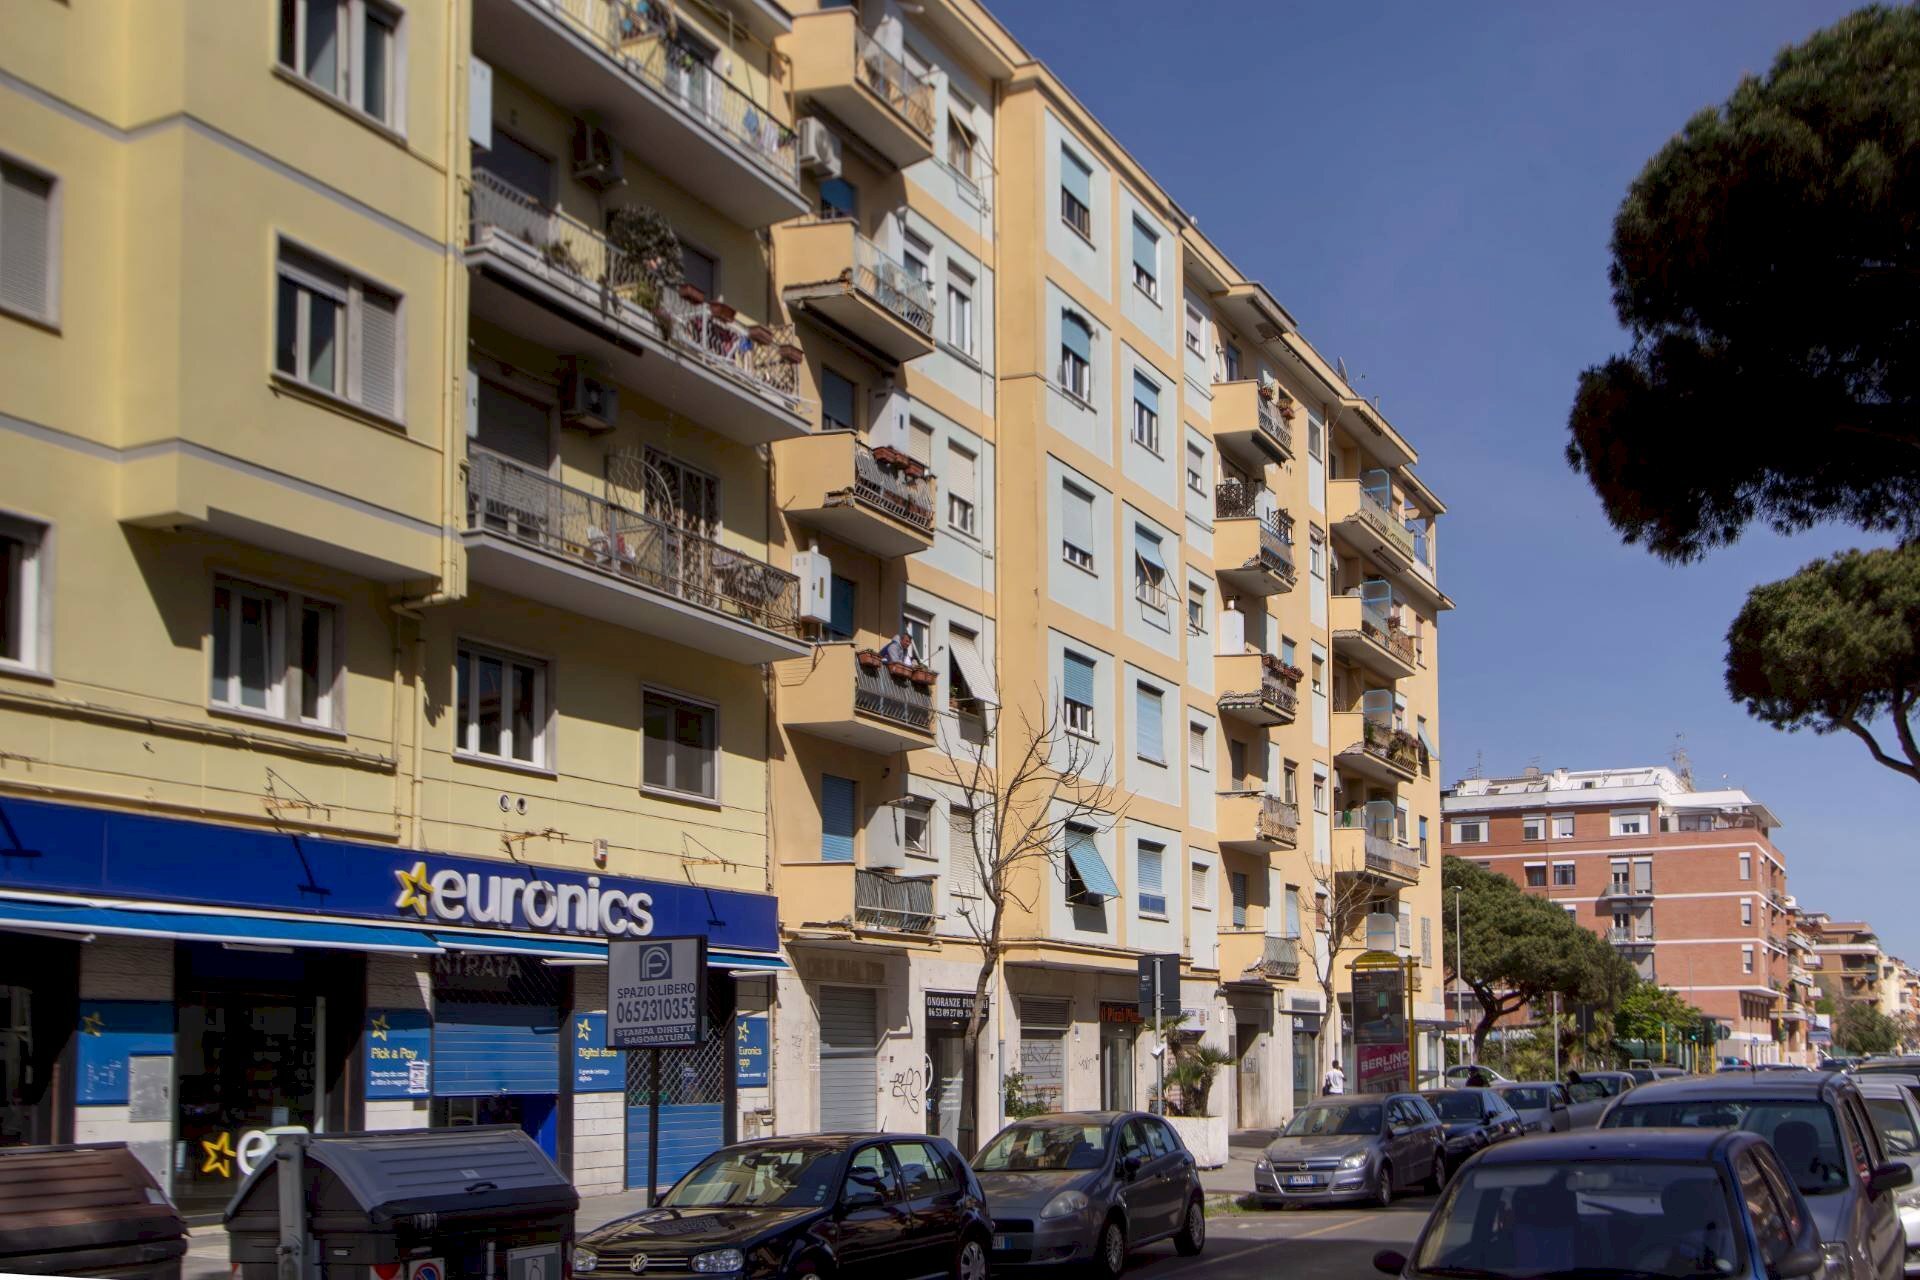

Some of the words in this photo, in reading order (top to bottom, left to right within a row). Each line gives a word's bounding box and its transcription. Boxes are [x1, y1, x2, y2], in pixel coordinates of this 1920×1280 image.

[431, 869, 654, 936] euronics
[617, 986, 655, 999] SPAZIO
[658, 983, 696, 996] LIBERO
[927, 996, 961, 1008] ONORANZE
[616, 997, 696, 1023] 0652310353
[616, 1027, 654, 1037] STAMPA
[657, 1025, 696, 1034] DIRETTA
[624, 1033, 691, 1044] SAGOMATURA
[371, 1047, 390, 1059] Pick
[1361, 1050, 1410, 1072] BERLINO
